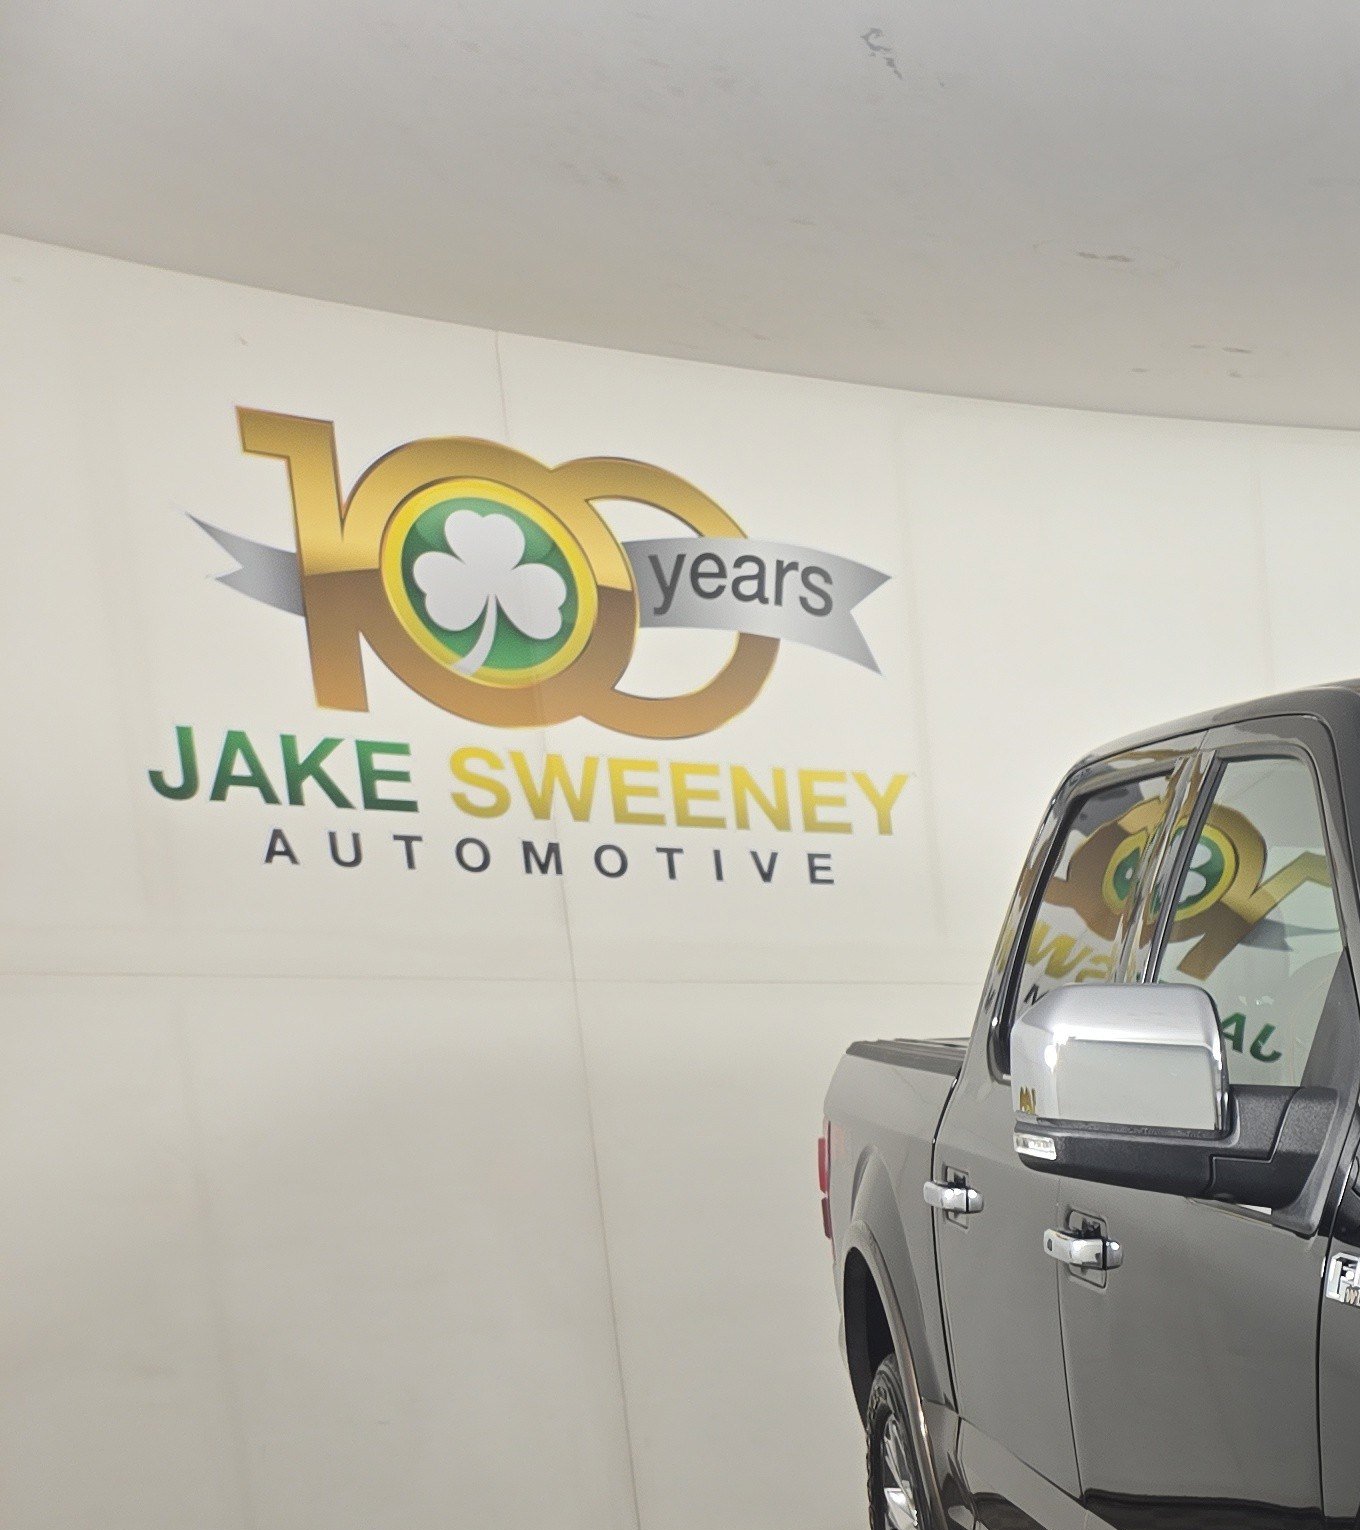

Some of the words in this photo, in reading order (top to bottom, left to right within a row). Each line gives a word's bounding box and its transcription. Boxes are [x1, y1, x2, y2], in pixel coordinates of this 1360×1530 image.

[235, 404, 780, 739] 100
[648, 550, 835, 617] years
[148, 725, 420, 813] JAKE
[449, 745, 910, 837] SWEENEY
[264, 828, 836, 886] AUTOMOTIVE
